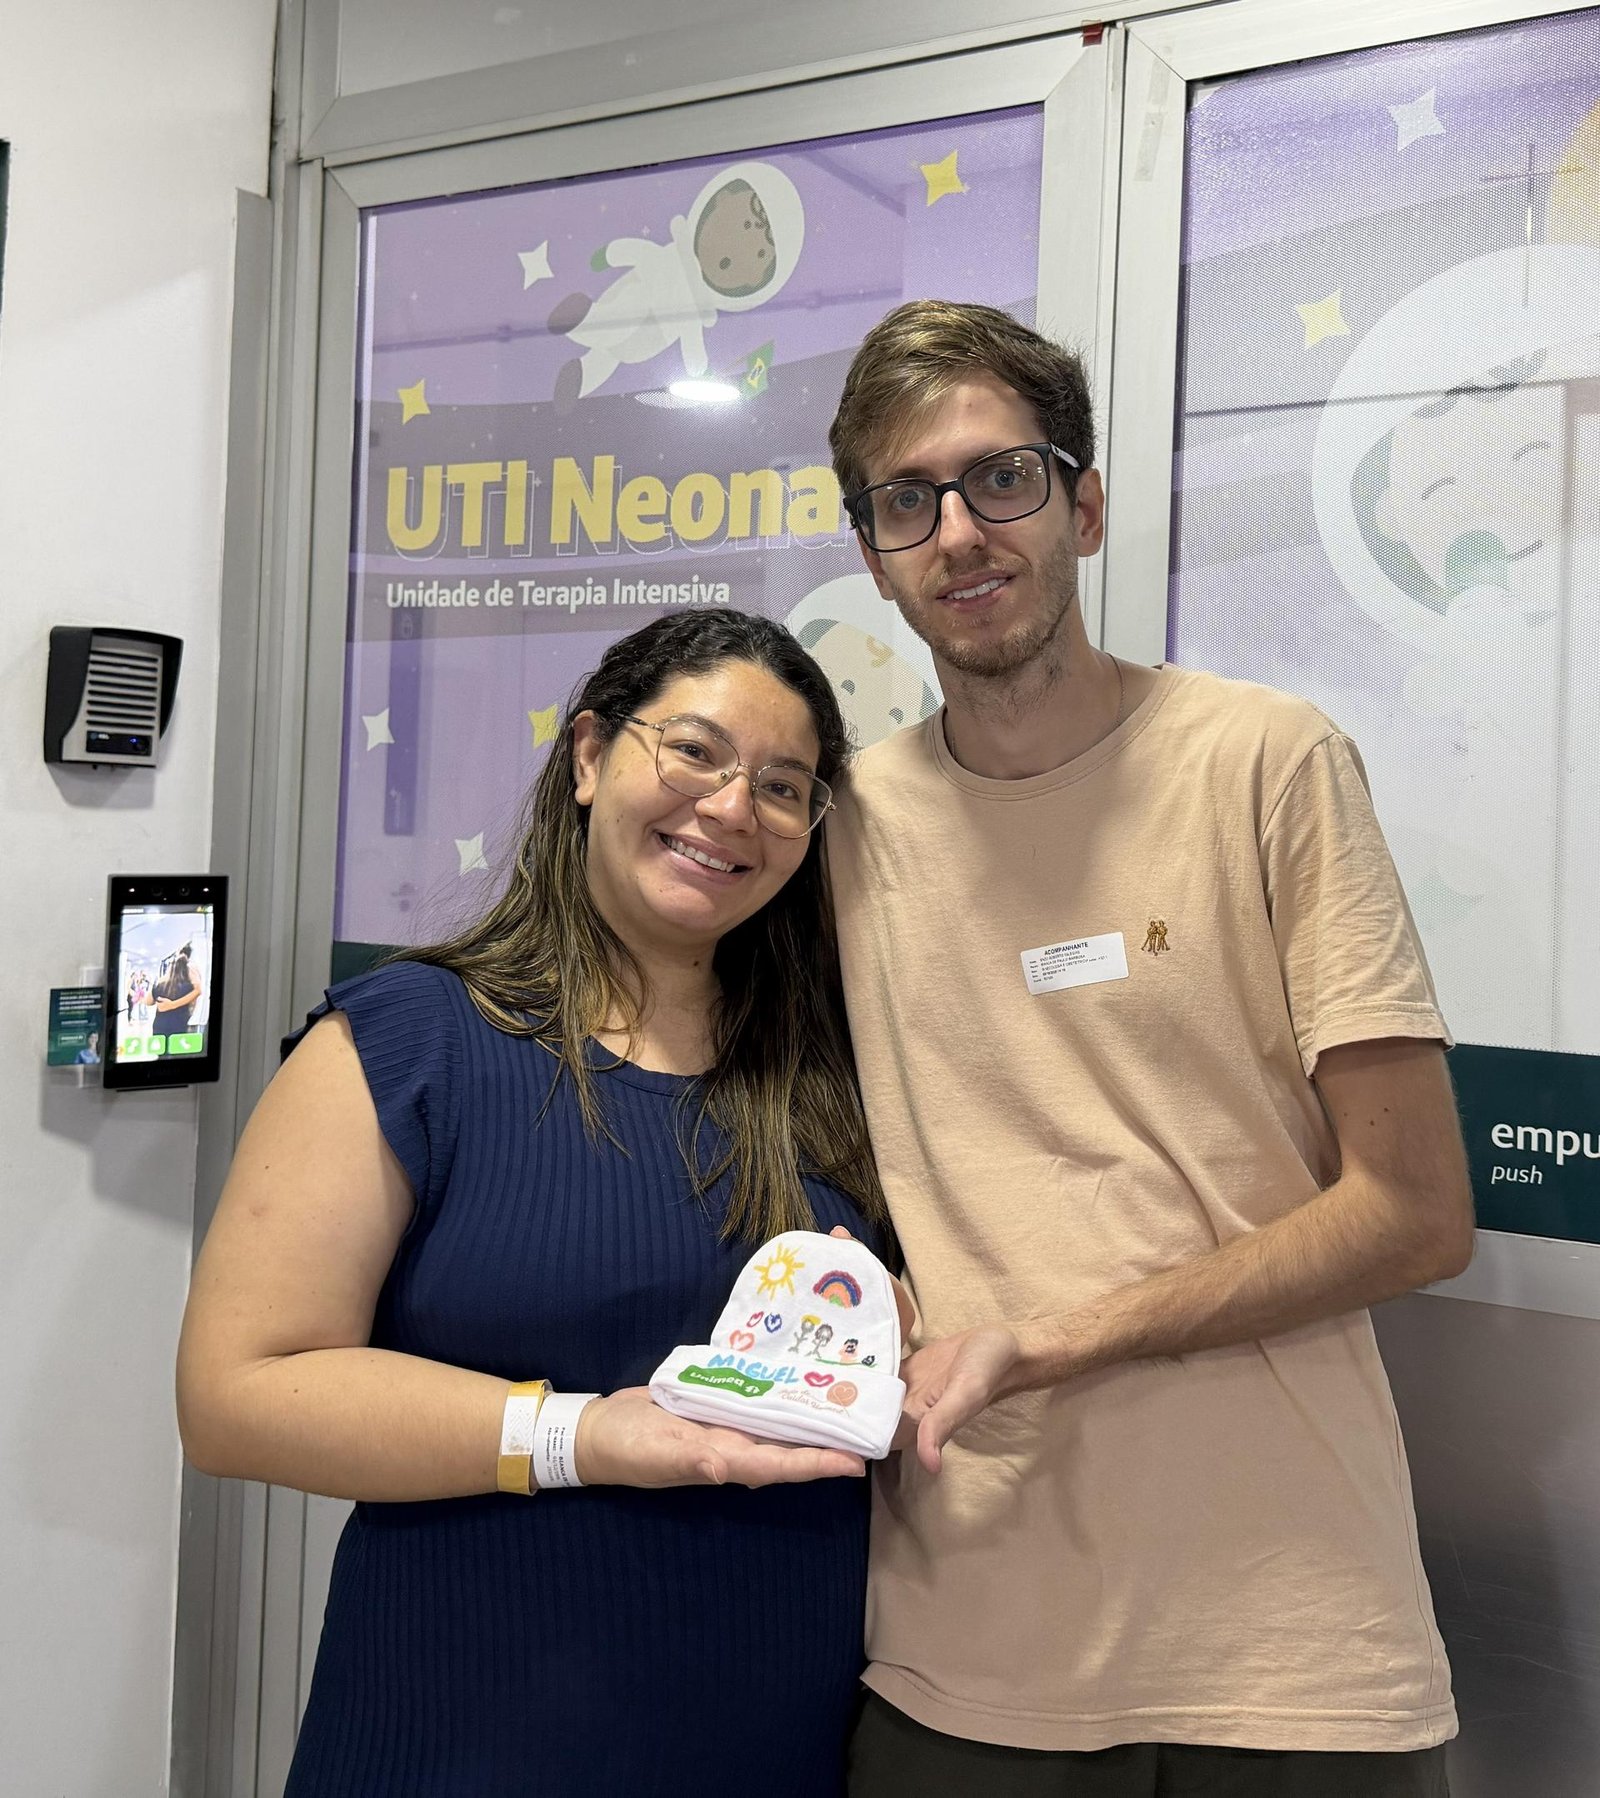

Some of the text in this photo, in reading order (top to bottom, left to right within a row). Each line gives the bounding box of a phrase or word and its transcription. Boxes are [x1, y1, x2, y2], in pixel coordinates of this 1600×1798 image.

[387, 455, 841, 551] UTI Neona
[387, 575, 730, 614] Unidade de Terapia Intensiva
[1044, 942, 1089, 955] ACOMPANHANTE
[1491, 1123, 1600, 1165] empu
[1491, 1165, 1543, 1184] push
[707, 1354, 799, 1384] MIGUEL
